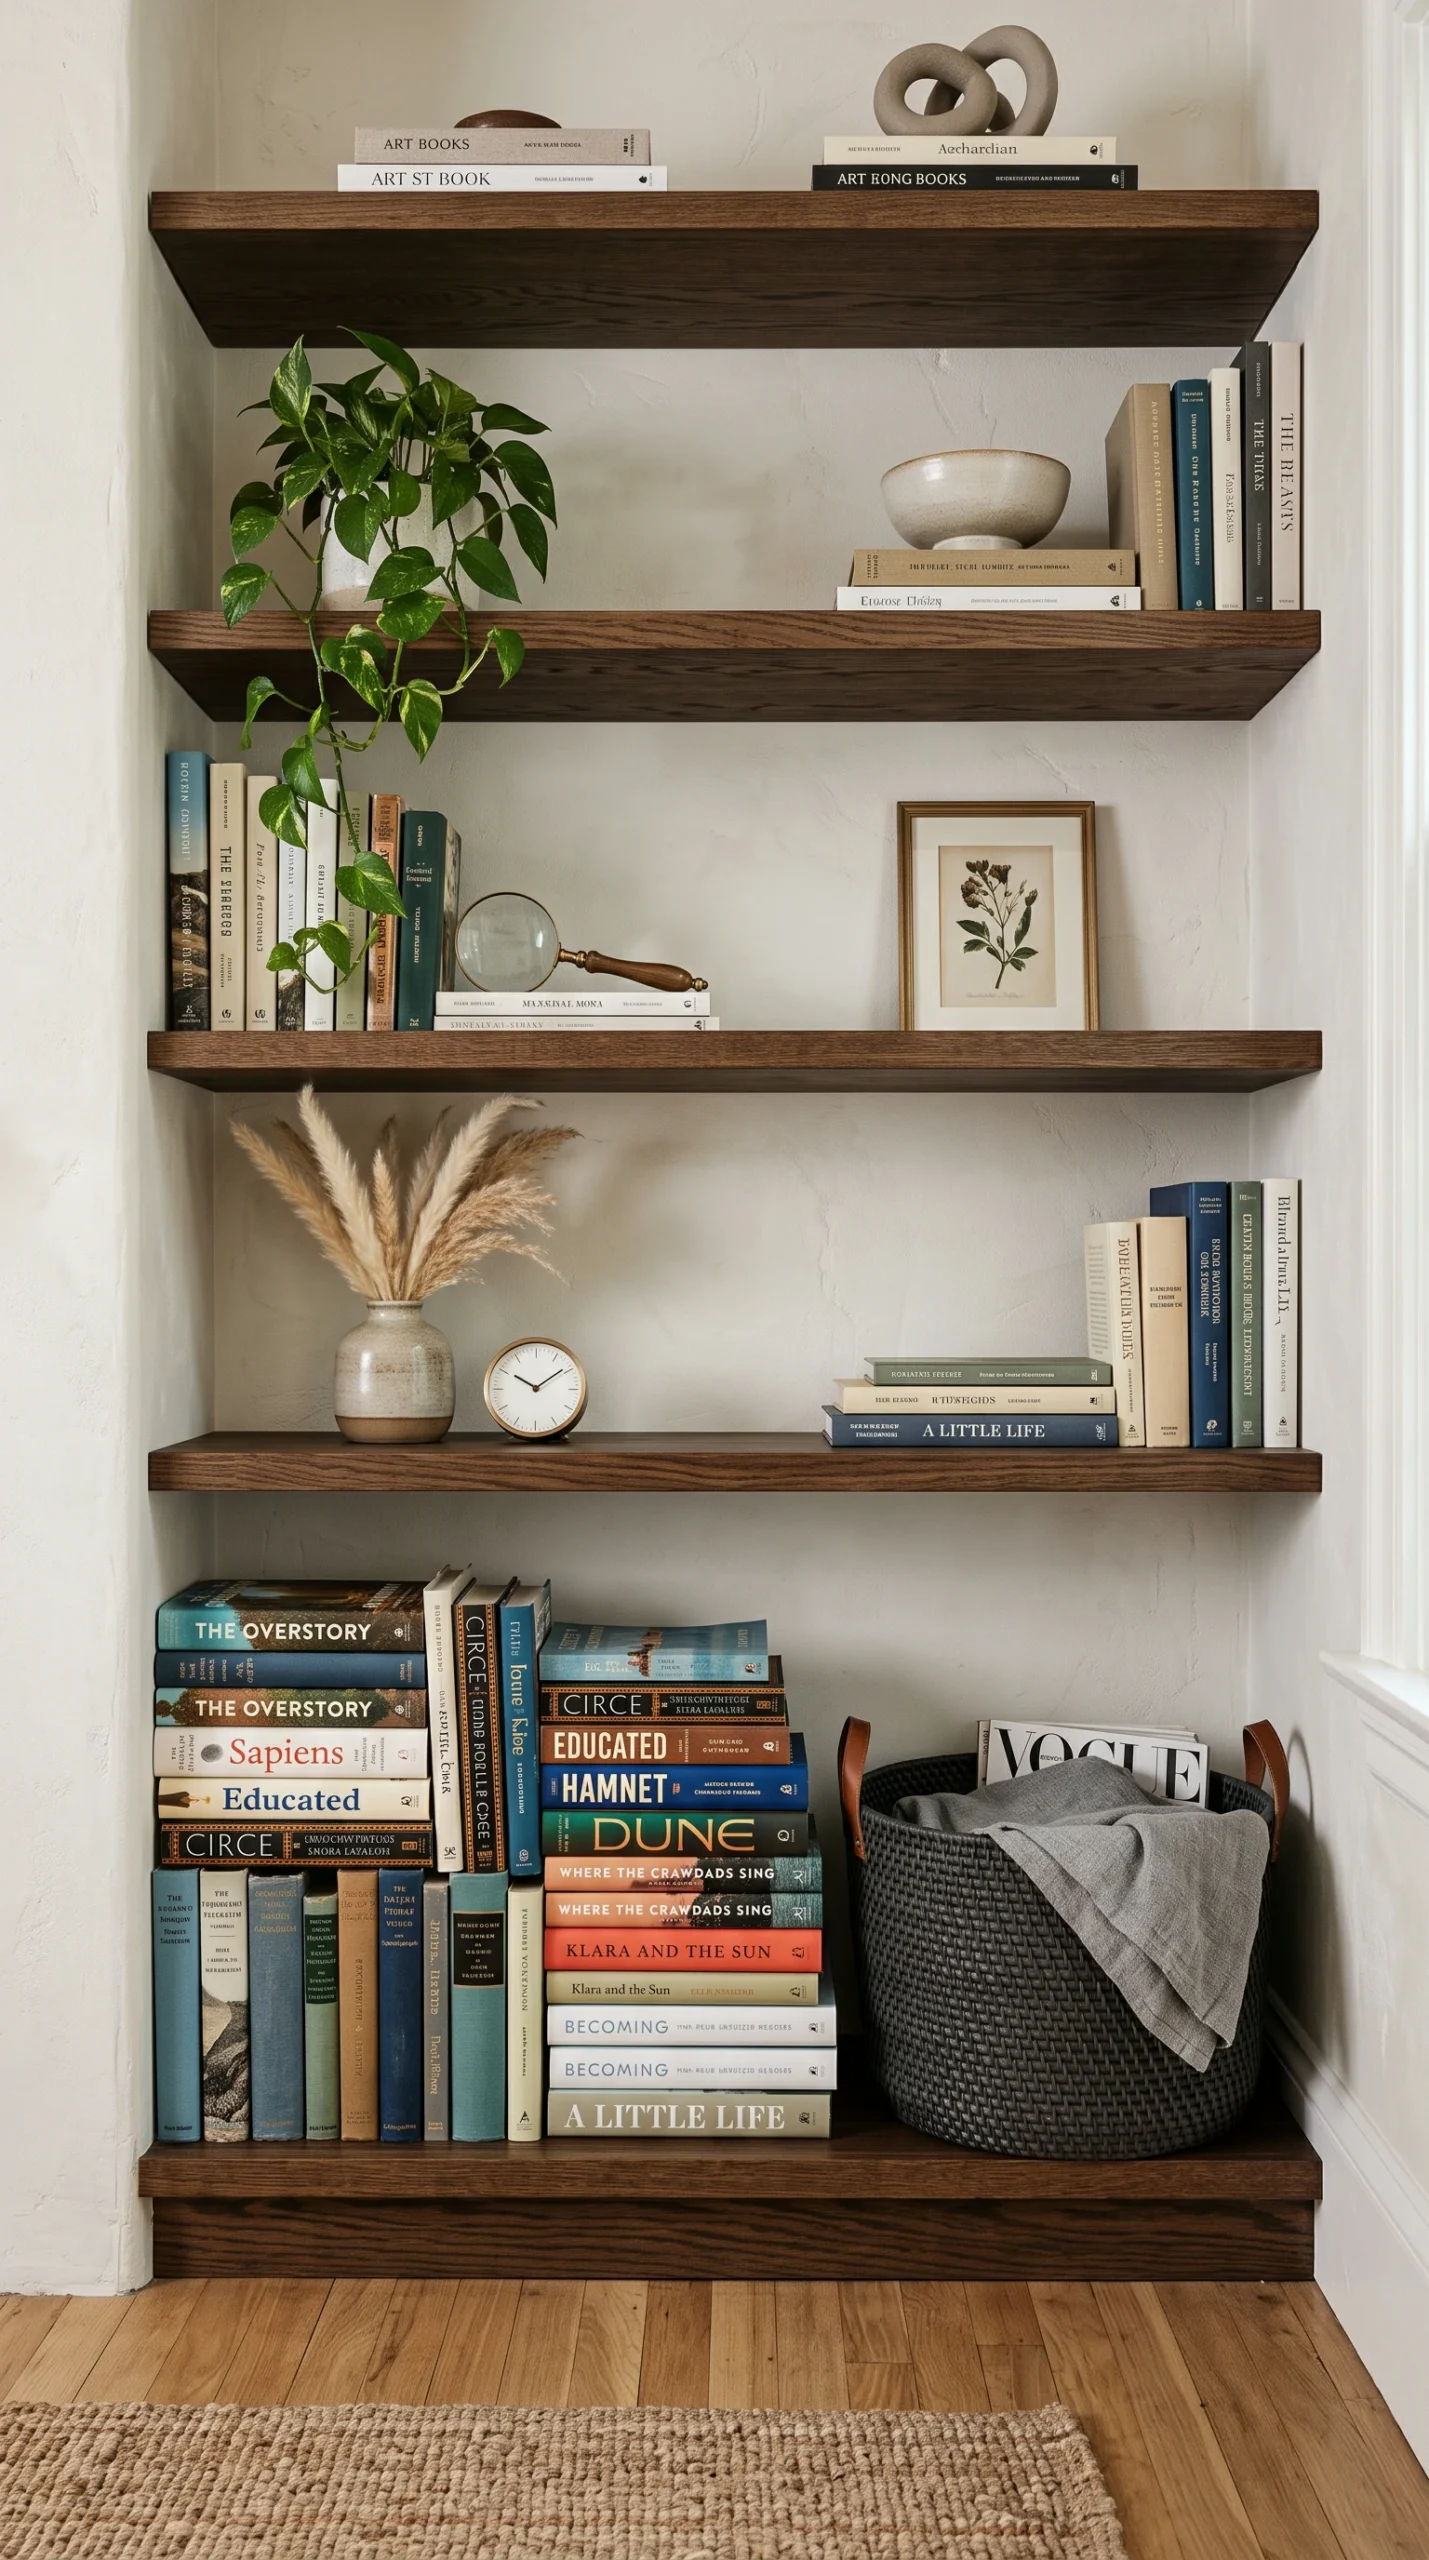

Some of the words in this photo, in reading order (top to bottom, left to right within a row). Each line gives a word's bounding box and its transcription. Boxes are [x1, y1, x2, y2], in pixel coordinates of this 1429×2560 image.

[384, 138, 413, 150] ART
[419, 138, 470, 150] BOOKS
[371, 172, 407, 186] ART
[412, 172, 434, 186] ST
[439, 172, 491, 186] BOOK
[837, 173, 867, 185] ART
[915, 173, 967, 185] BOOKS
[1280, 413, 1294, 452] THE
[220, 846, 232, 873] THE
[923, 1424, 935, 1437] A
[940, 1424, 1002, 1437] LITTLE
[1006, 1424, 1045, 1437] LIFE
[195, 1622, 235, 1639] THE
[243, 1622, 371, 1640] OVERSTORY
[465, 1616, 487, 1683] CIRCE
[195, 1700, 236, 1717] THE
[243, 1700, 372, 1718] OVERSTORY
[563, 1694, 642, 1715] CIRCE
[554, 1731, 667, 1760] EDUCATED
[229, 1738, 344, 1773] Sapiens
[562, 1773, 668, 1803] HAMNET
[222, 1787, 360, 1811] Educated
[593, 1818, 755, 1851] DUNE
[186, 1834, 273, 1857] CIRCE
[559, 1867, 611, 1878] WHERE
[617, 1868, 645, 1878] THE
[651, 1868, 734, 1879] CRAWDADS
[739, 1868, 775, 1879] SING
[558, 1904, 610, 1915] WHERE
[616, 1904, 644, 1915] THE
[650, 1904, 731, 1916] CRAWDADS
[736, 1905, 772, 1916] SING
[566, 1943, 631, 1958] KLARA
[637, 1944, 679, 1958] AND
[686, 1944, 725, 1958] THE
[732, 1945, 771, 1959] SUN
[571, 1983, 602, 1995] Klara
[604, 1983, 626, 1995] and
[628, 1984, 646, 1995] the
[648, 1984, 671, 1995] Sun
[565, 2019, 669, 2034] BECOMING
[565, 2063, 669, 2077] BECOMING
[564, 2103, 586, 2128] A
[594, 2104, 705, 2129] LITTLE
[715, 2105, 785, 2130] LIFE
